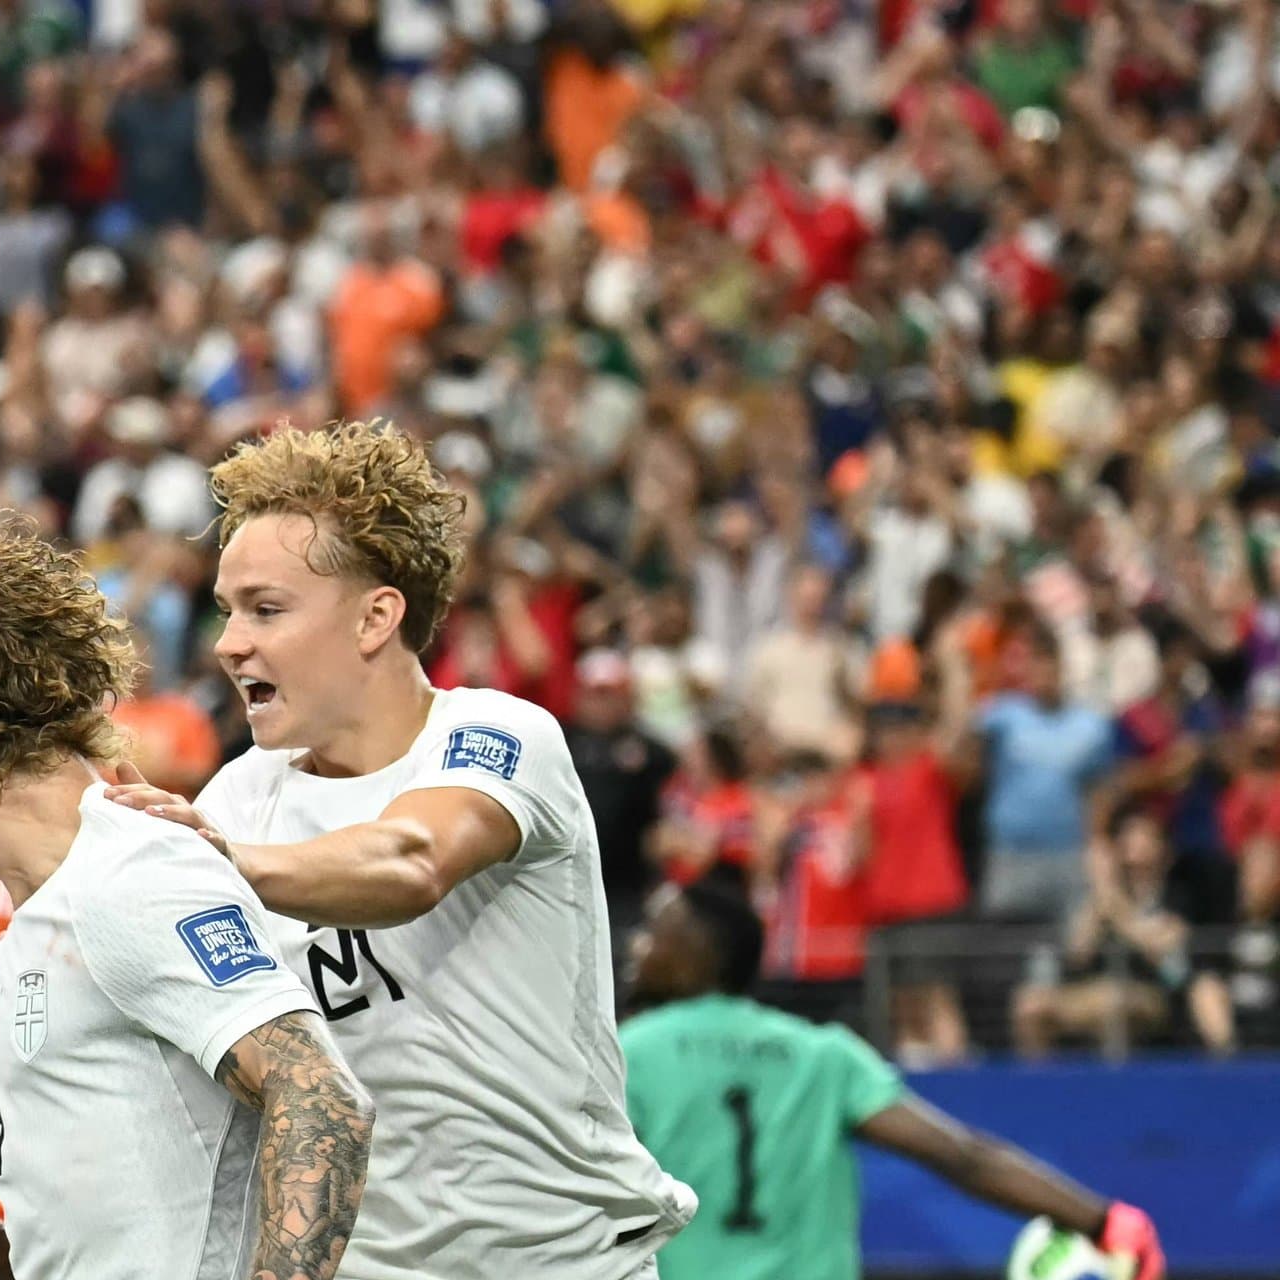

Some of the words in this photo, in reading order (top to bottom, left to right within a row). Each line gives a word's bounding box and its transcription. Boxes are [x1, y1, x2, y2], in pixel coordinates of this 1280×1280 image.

[193, 918, 240, 938] FOOTBALL
[200, 929, 246, 952] UNITES
[209, 950, 229, 966] the
[720, 1083, 769, 1236] 1
